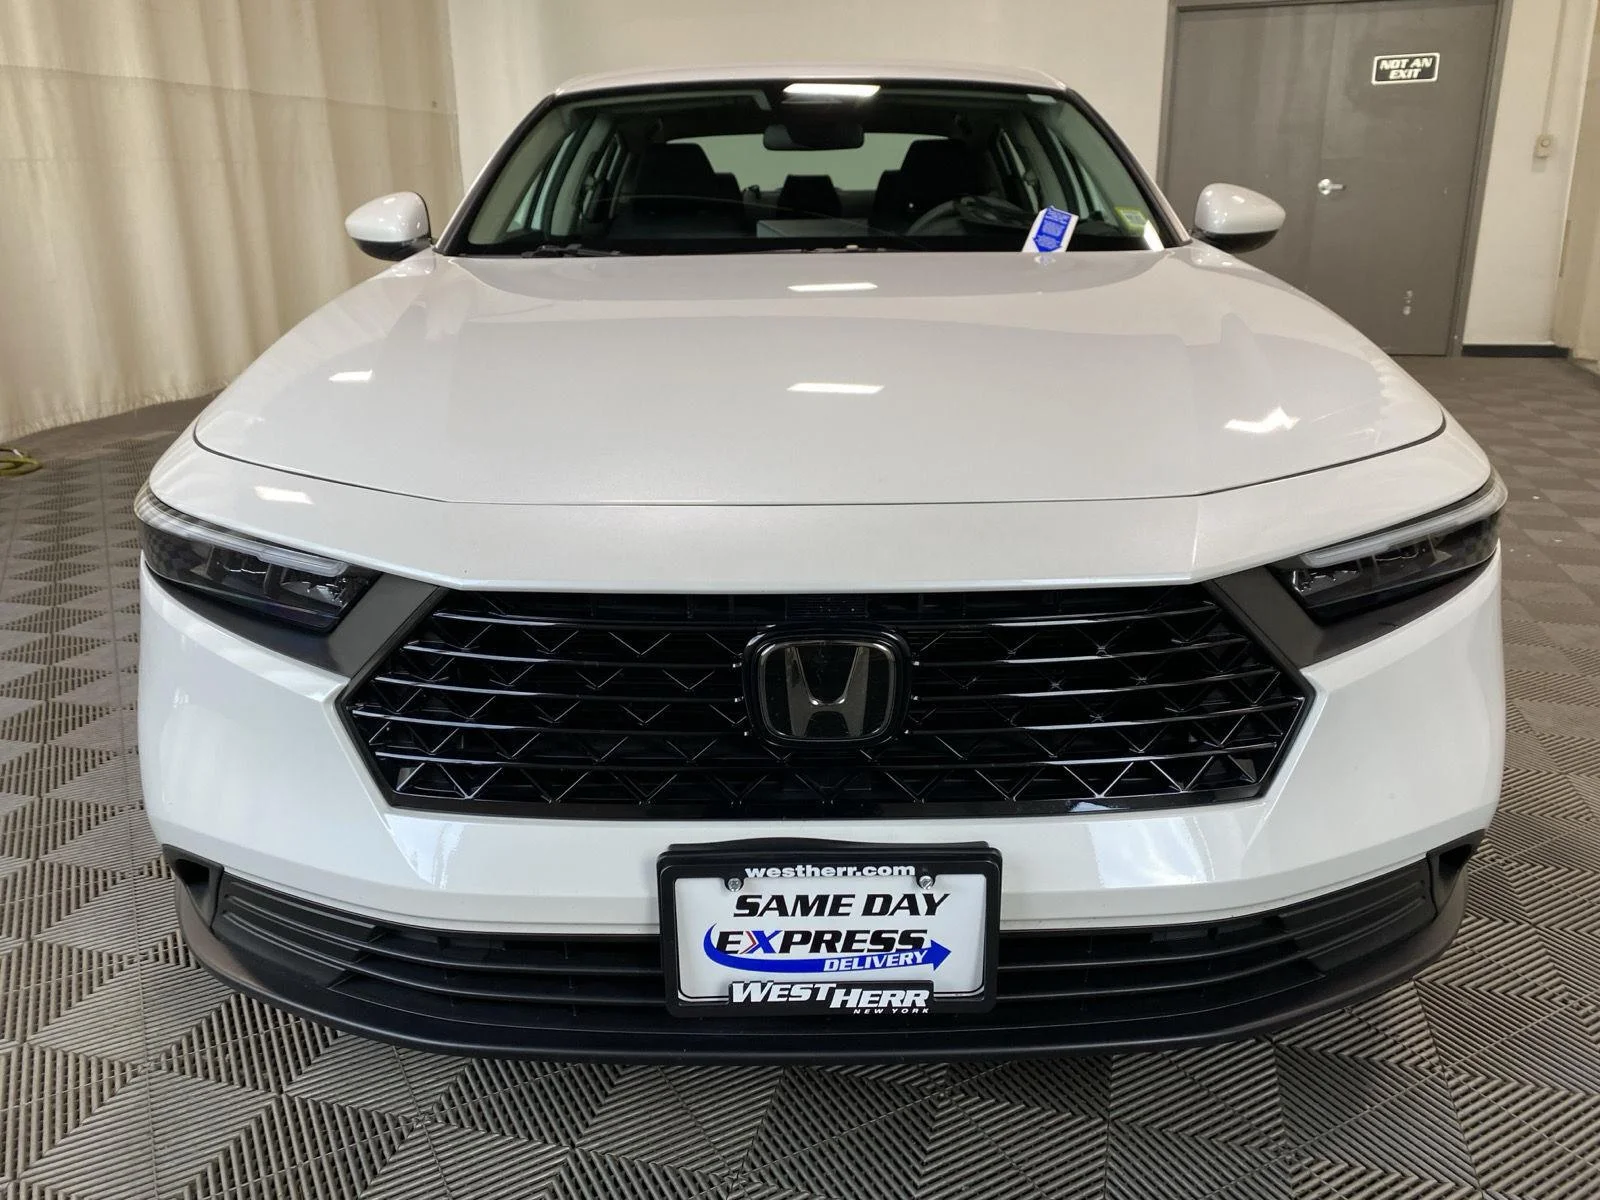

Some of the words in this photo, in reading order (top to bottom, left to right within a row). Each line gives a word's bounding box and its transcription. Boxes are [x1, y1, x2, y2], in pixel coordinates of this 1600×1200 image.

[1380, 59, 1409, 70] NOT
[1410, 57, 1433, 68] AN
[1389, 68, 1421, 80] EXIT
[745, 865, 915, 878] westherr.com
[733, 894, 855, 917] SAME
[861, 893, 950, 917] DAY
[717, 930, 927, 954] EXPRESS
[823, 951, 927, 972] DELIVERY
